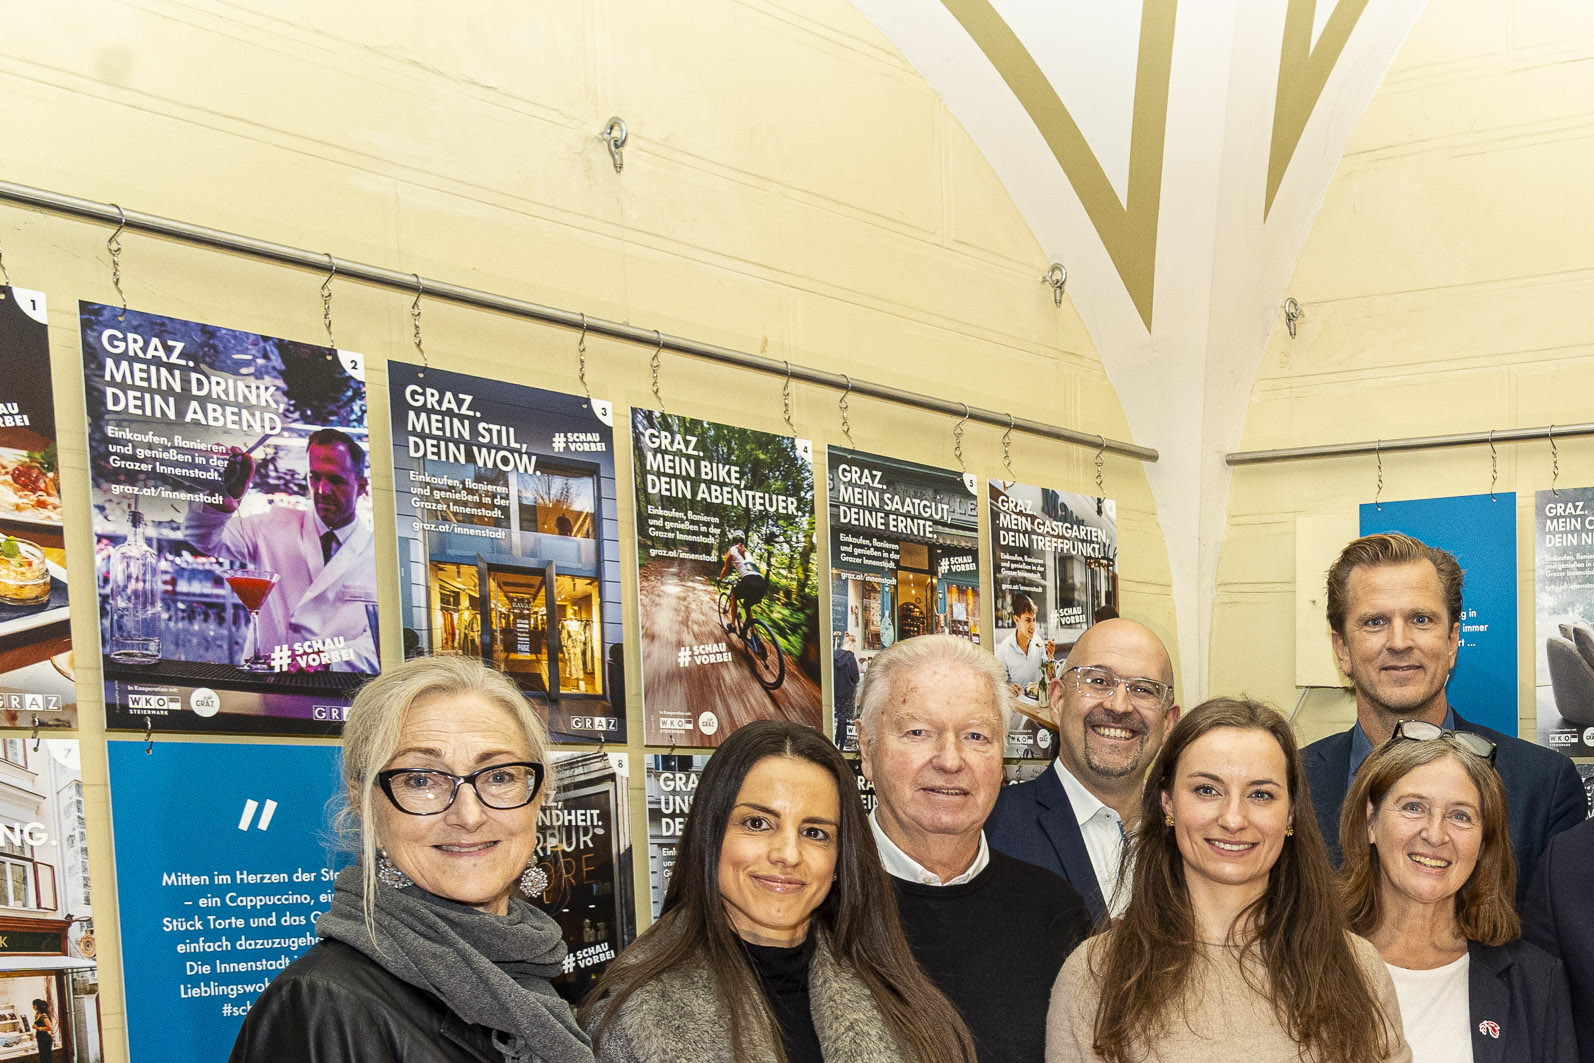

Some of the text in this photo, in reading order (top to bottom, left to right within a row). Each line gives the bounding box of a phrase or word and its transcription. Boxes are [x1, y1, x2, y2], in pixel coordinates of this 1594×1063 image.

[30, 299, 36, 311] 1
[101, 329, 195, 367] GRAZ.
[350, 359, 358, 370] 2
[105, 358, 285, 413] MEIN DRINK,
[405, 385, 481, 417] GRAZ.
[106, 387, 289, 437] DEIN ABEND.
[601, 407, 607, 417] 3
[108, 426, 226, 453] Einkaufen, flanieren
[407, 411, 527, 452] MEIN STIL,
[568, 442, 606, 452] VORBEI
[645, 429, 704, 456] GRAZ.
[109, 445, 228, 468] und genießen in der
[408, 436, 541, 475] DEIN WOW.
[109, 457, 221, 481] Grazer Innenstadt.
[647, 452, 745, 489] MEIN BIKE,
[838, 464, 887, 489] GRAZ.
[969, 479, 974, 487] 5
[111, 484, 224, 504] graz.at/innenstadt
[647, 475, 802, 516] DEIN ABENTEUER.
[839, 485, 880, 508] MEIN
[884, 493, 952, 524] SAATGUT,
[998, 496, 1036, 515] GRAZ.
[1546, 502, 1588, 516] GRAZ.
[840, 506, 937, 538] DEINE ERNTE.
[999, 513, 1109, 544] MEIN GASTGARTEN,
[1546, 518, 1581, 532] MEIN
[1000, 530, 1101, 558] DEIN TREFFPUNKT.
[1546, 533, 1577, 547] DEIN
[951, 563, 976, 572] VORBEI
[1061, 614, 1086, 625] VORBEI
[1469, 608, 1477, 617] in
[1462, 624, 1488, 632] immer
[296, 648, 355, 668] VORBEI
[693, 652, 732, 664] VORBEI
[572, 717, 617, 731] GRAZ
[618, 760, 623, 768] 8
[162, 868, 316, 886] Mitten im Herzen der
[199, 891, 314, 909] ein Cappuccino,
[163, 912, 306, 931] Stück Torte und das
[177, 936, 231, 953] einfach
[186, 955, 290, 975] Die Innenstadt
[578, 950, 614, 968] VORBEI
